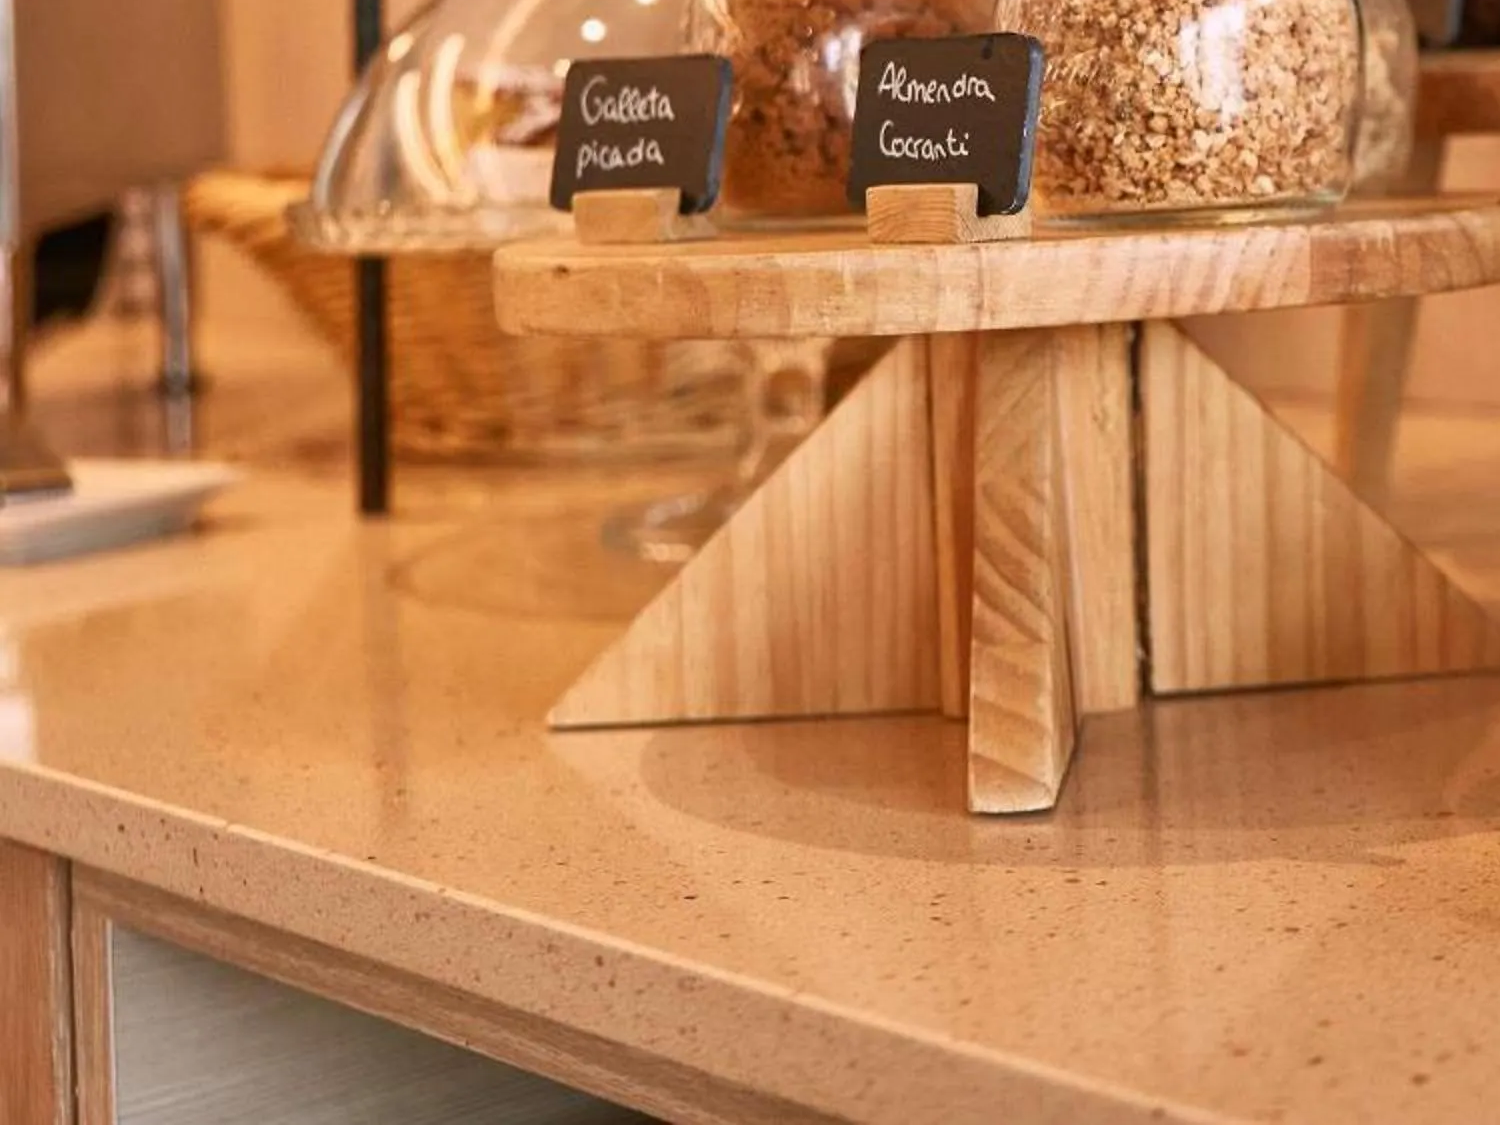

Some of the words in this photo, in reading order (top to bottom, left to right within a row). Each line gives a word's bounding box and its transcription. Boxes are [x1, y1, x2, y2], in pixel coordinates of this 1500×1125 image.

[580, 75, 675, 125] Galleta
[877, 60, 996, 104] Almendra
[575, 138, 665, 179] picada
